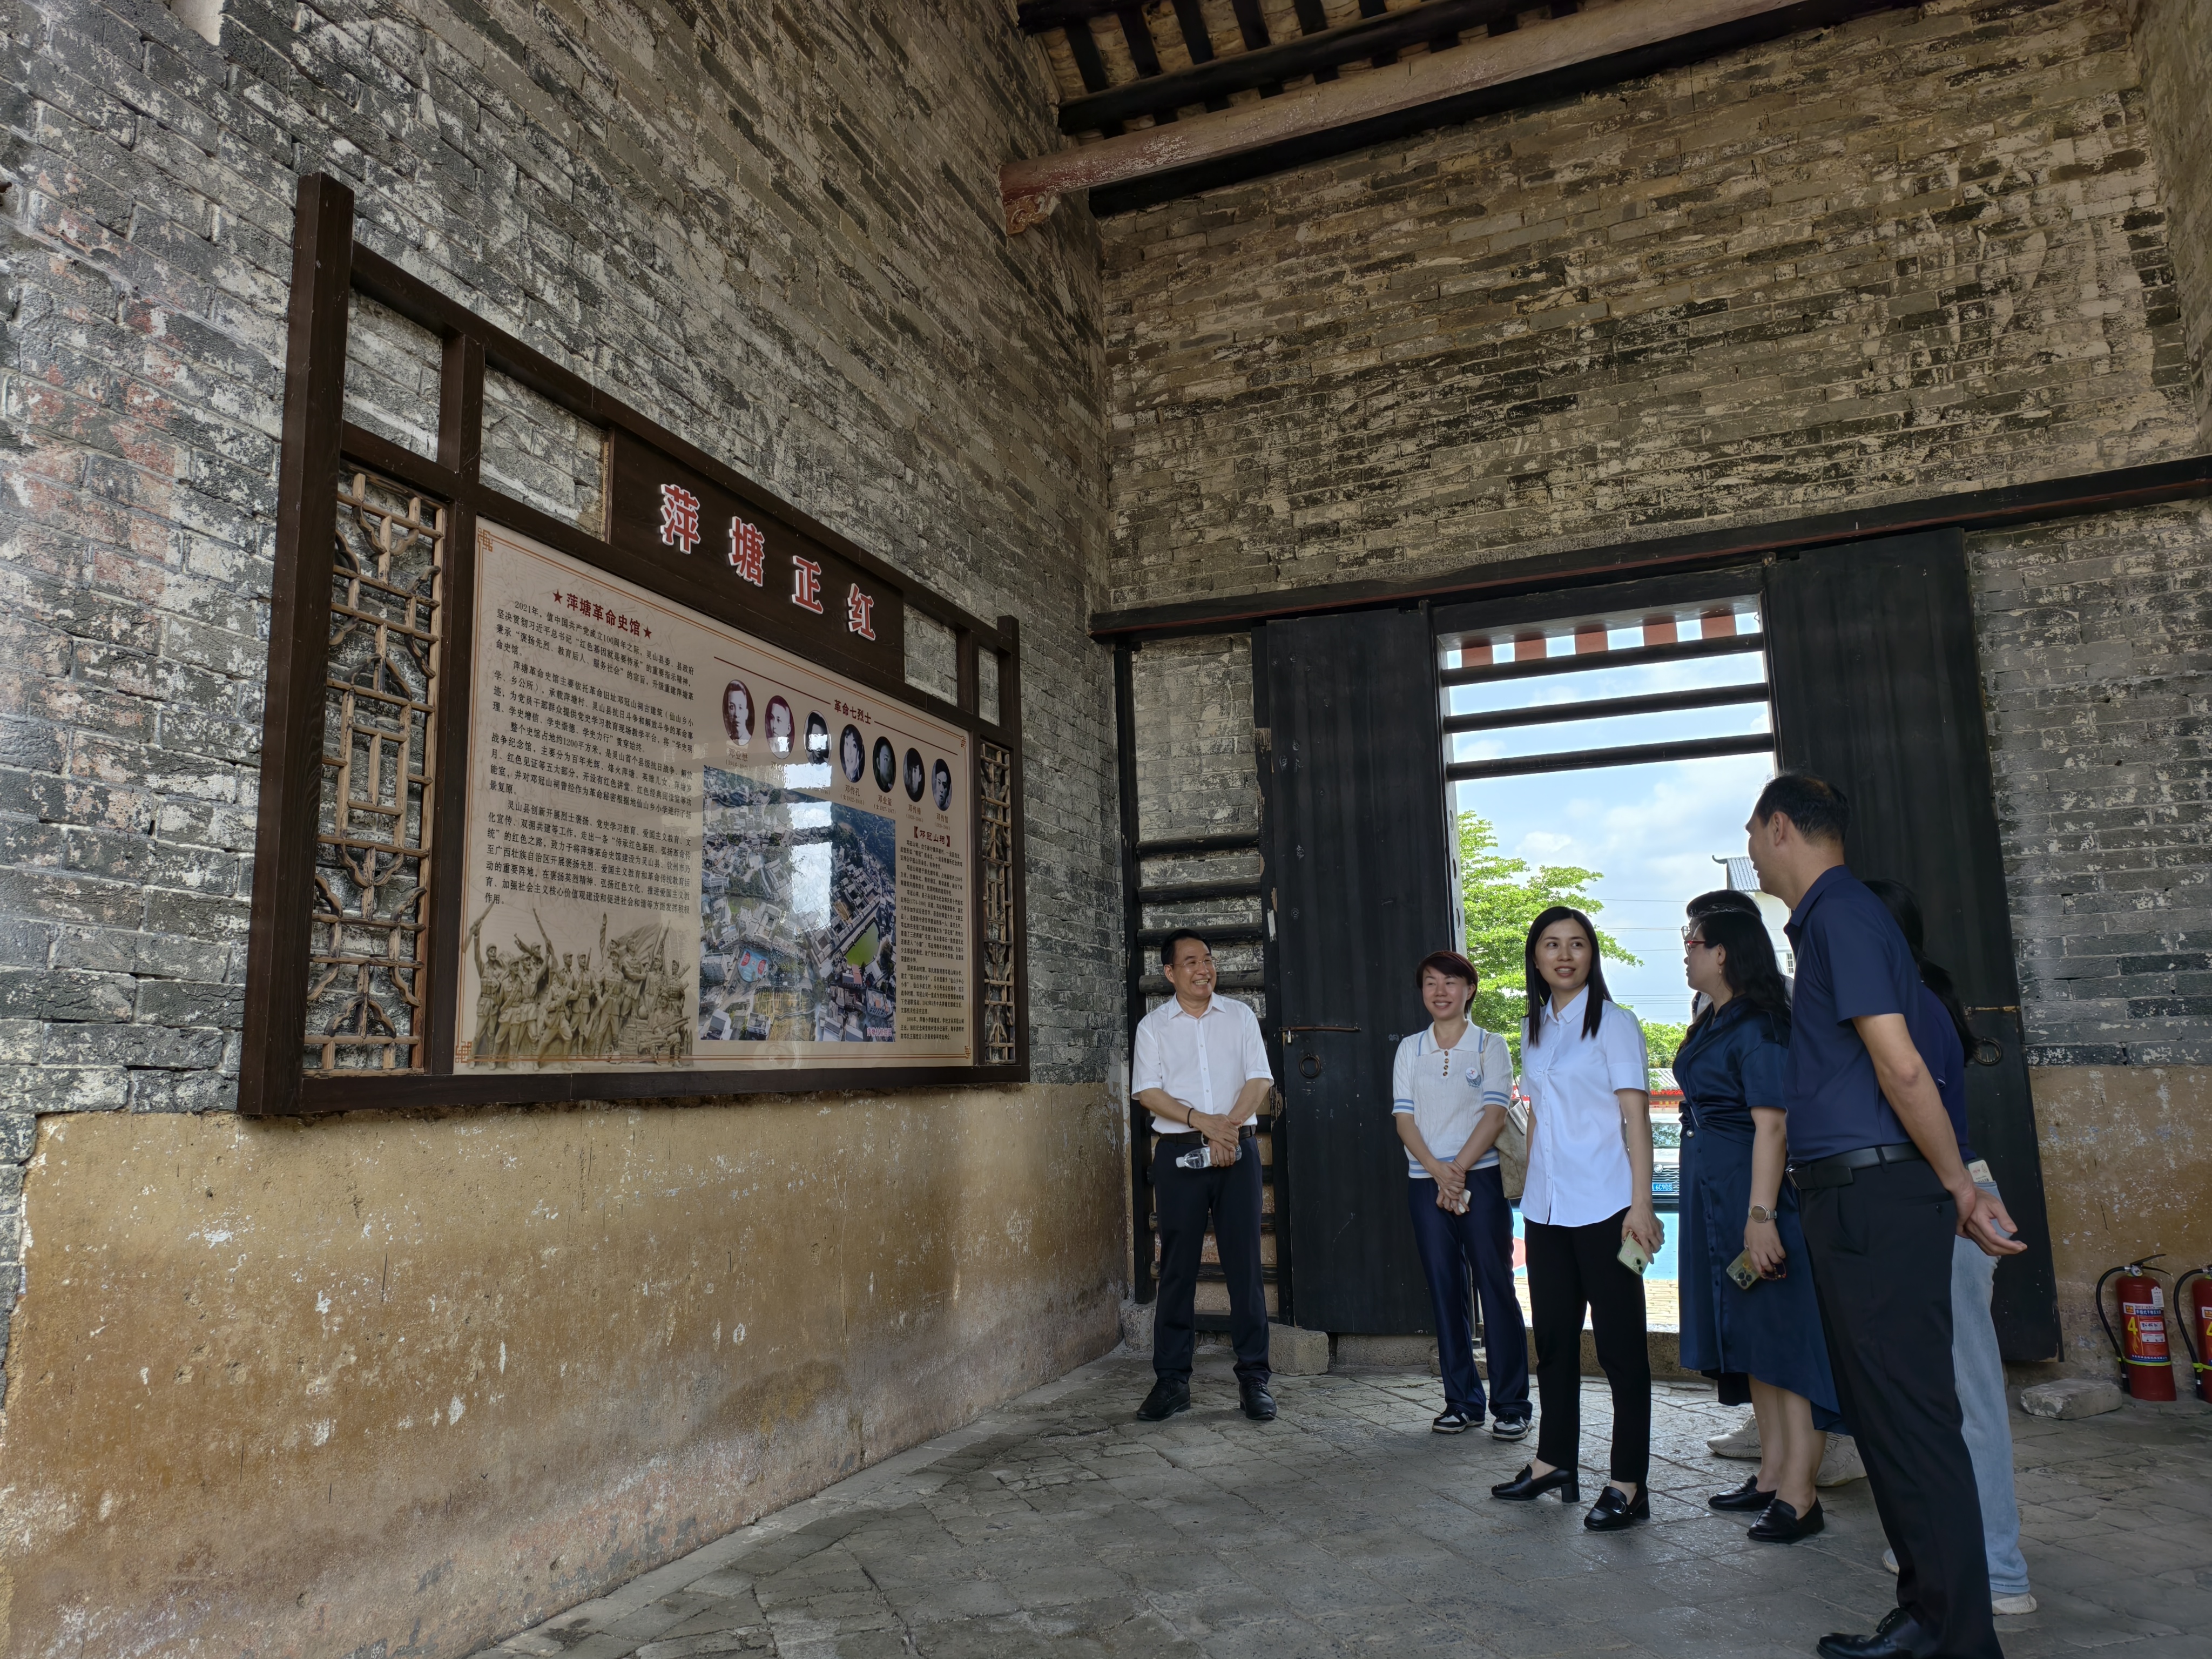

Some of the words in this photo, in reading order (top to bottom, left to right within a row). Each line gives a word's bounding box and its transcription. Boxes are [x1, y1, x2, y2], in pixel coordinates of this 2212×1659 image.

[660, 484, 876, 640] 萍塘正红
[566, 591, 640, 637] 萍塘革命史馆
[495, 637, 523, 658] 命史馆。
[834, 699, 871, 725] 革命七烈士
[489, 779, 518, 796] 景复原。
[845, 784, 860, 797] 邓传孔
[484, 892, 505, 905] 作用。
[2128, 1317, 2138, 1336] 4
